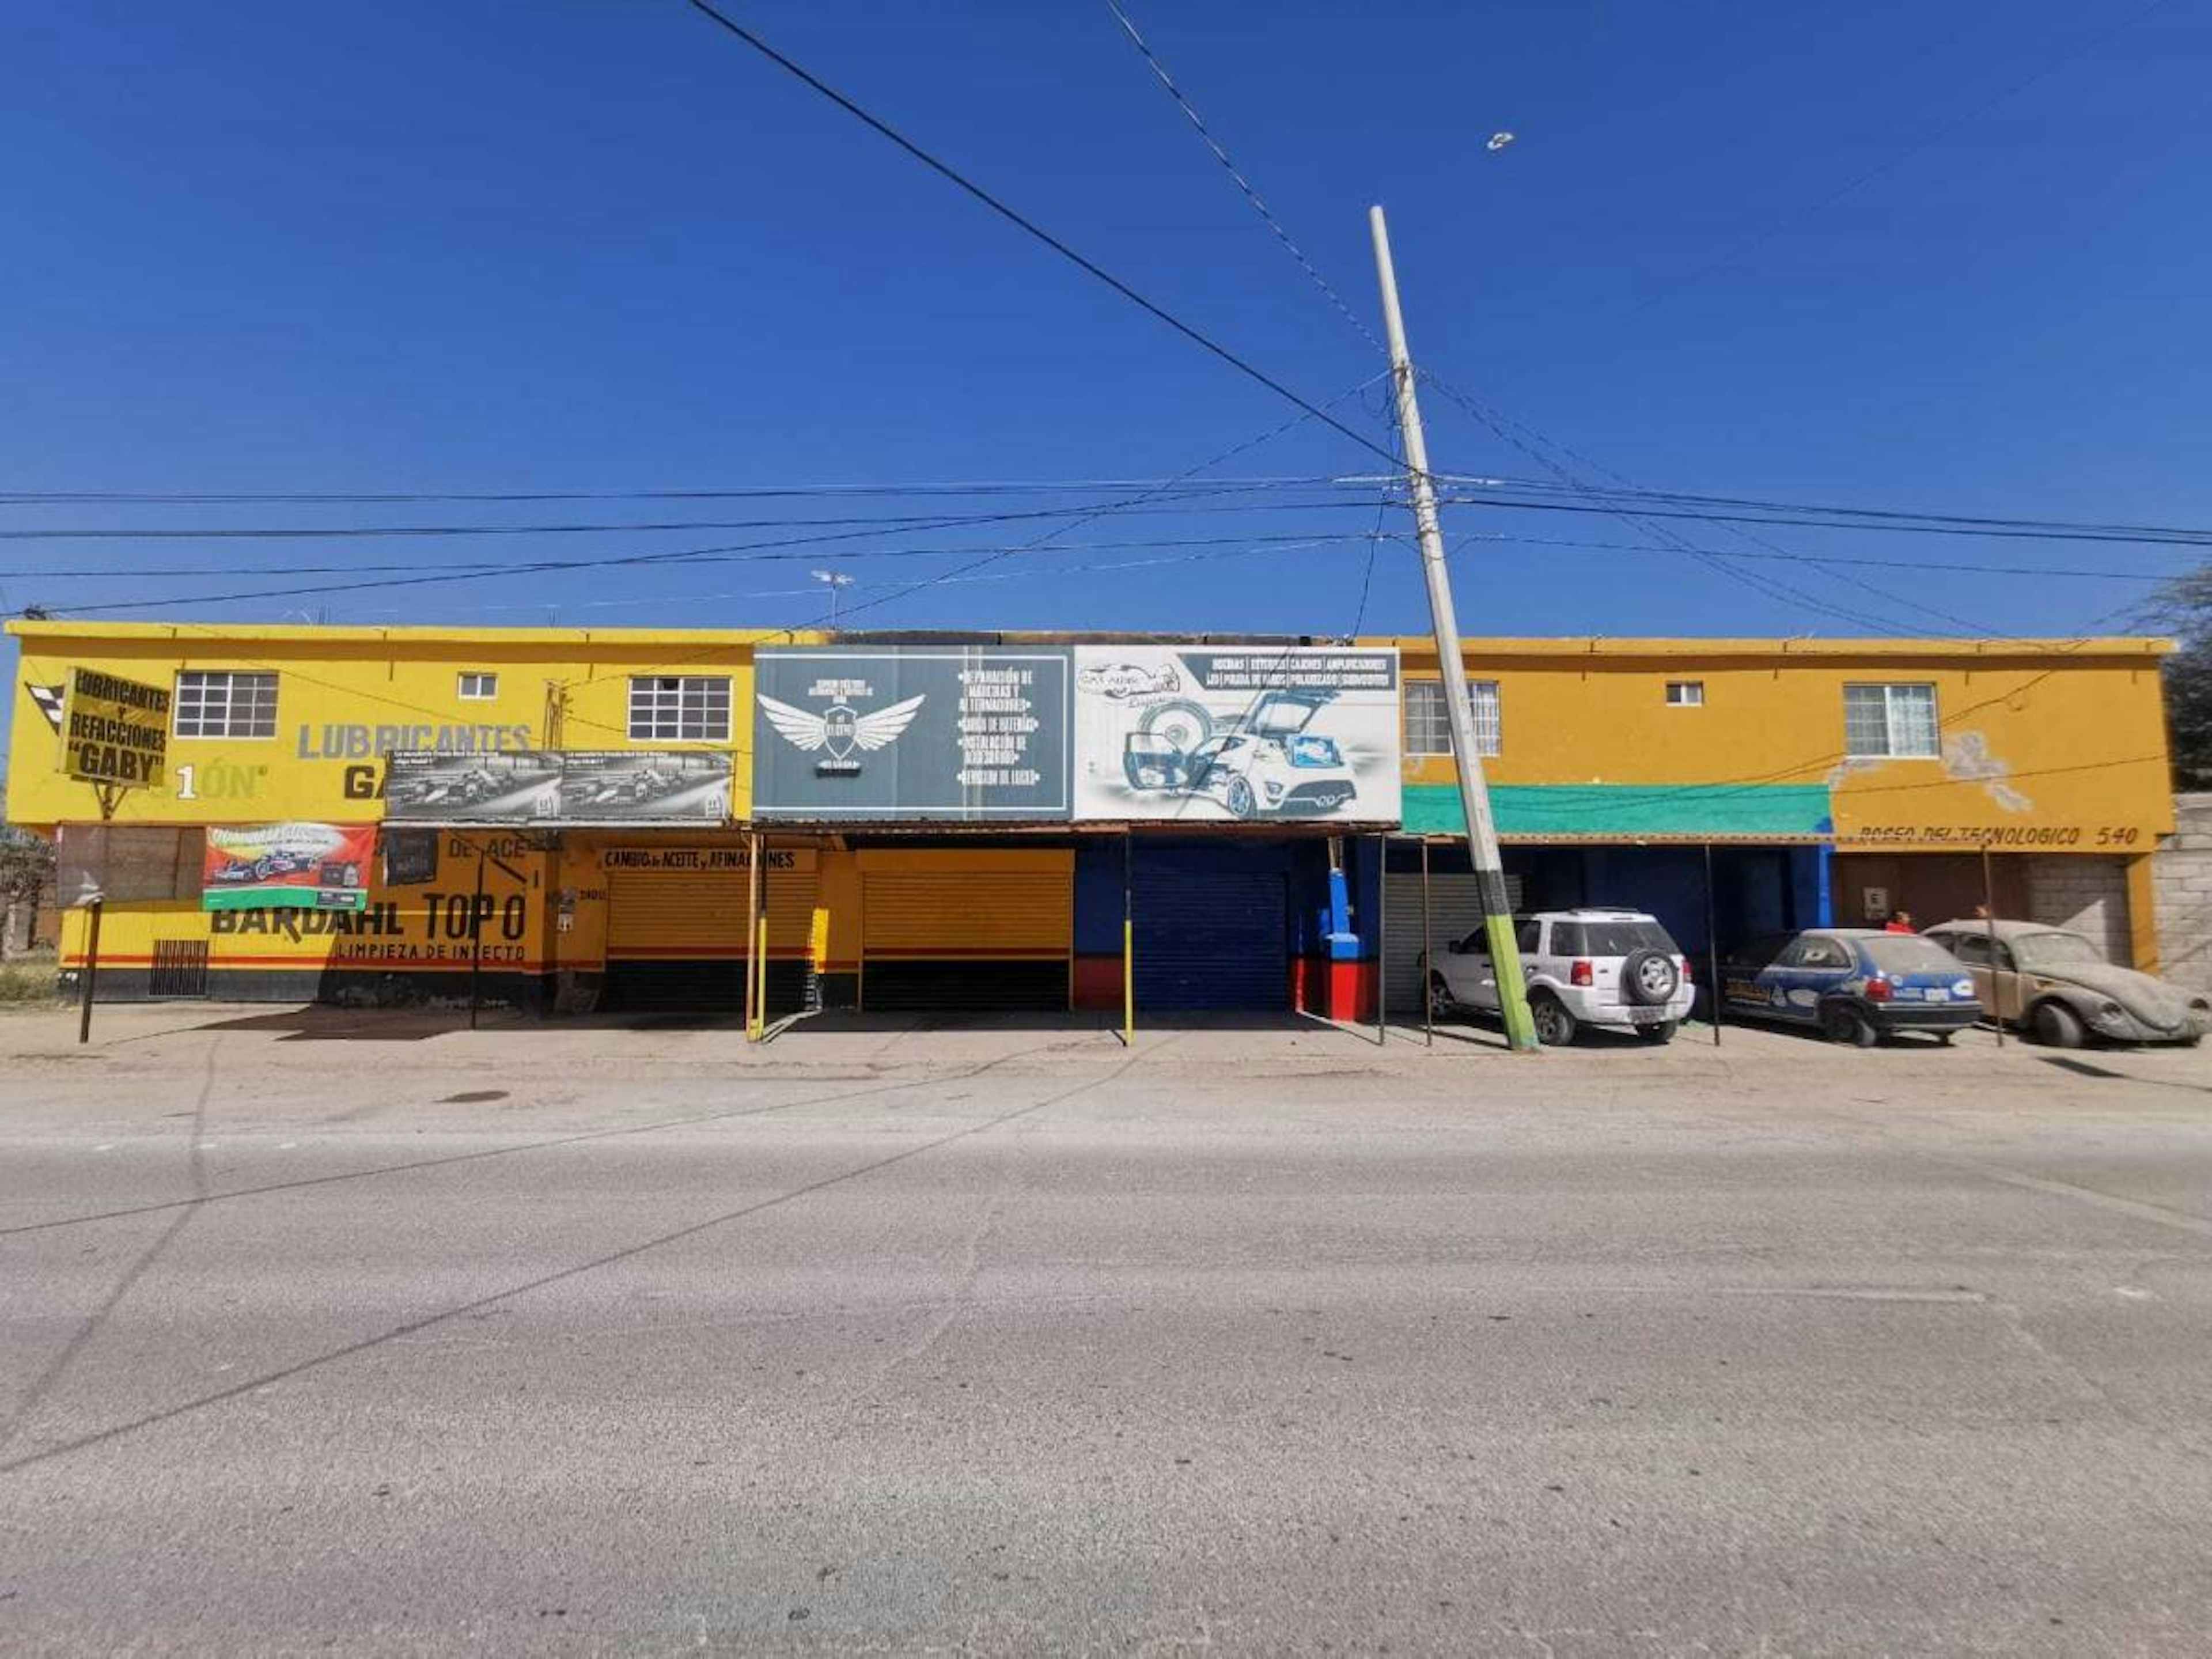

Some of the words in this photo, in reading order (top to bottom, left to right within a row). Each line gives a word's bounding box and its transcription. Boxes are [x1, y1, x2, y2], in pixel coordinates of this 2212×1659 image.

[75, 668, 171, 713] LUBRICANTES
[118, 706, 127, 721] Y
[70, 712, 166, 753] REFACCIONES
[297, 724, 532, 759] LUBRICANTES
[2095, 827, 2138, 844] 540
[605, 850, 650, 868] CAMBIO
[662, 850, 700, 868] ACEITE
[211, 903, 404, 944] BARDAHL
[423, 893, 493, 940] TOP
[339, 942, 418, 959] LIMPIEZA
[426, 944, 446, 959] DE
